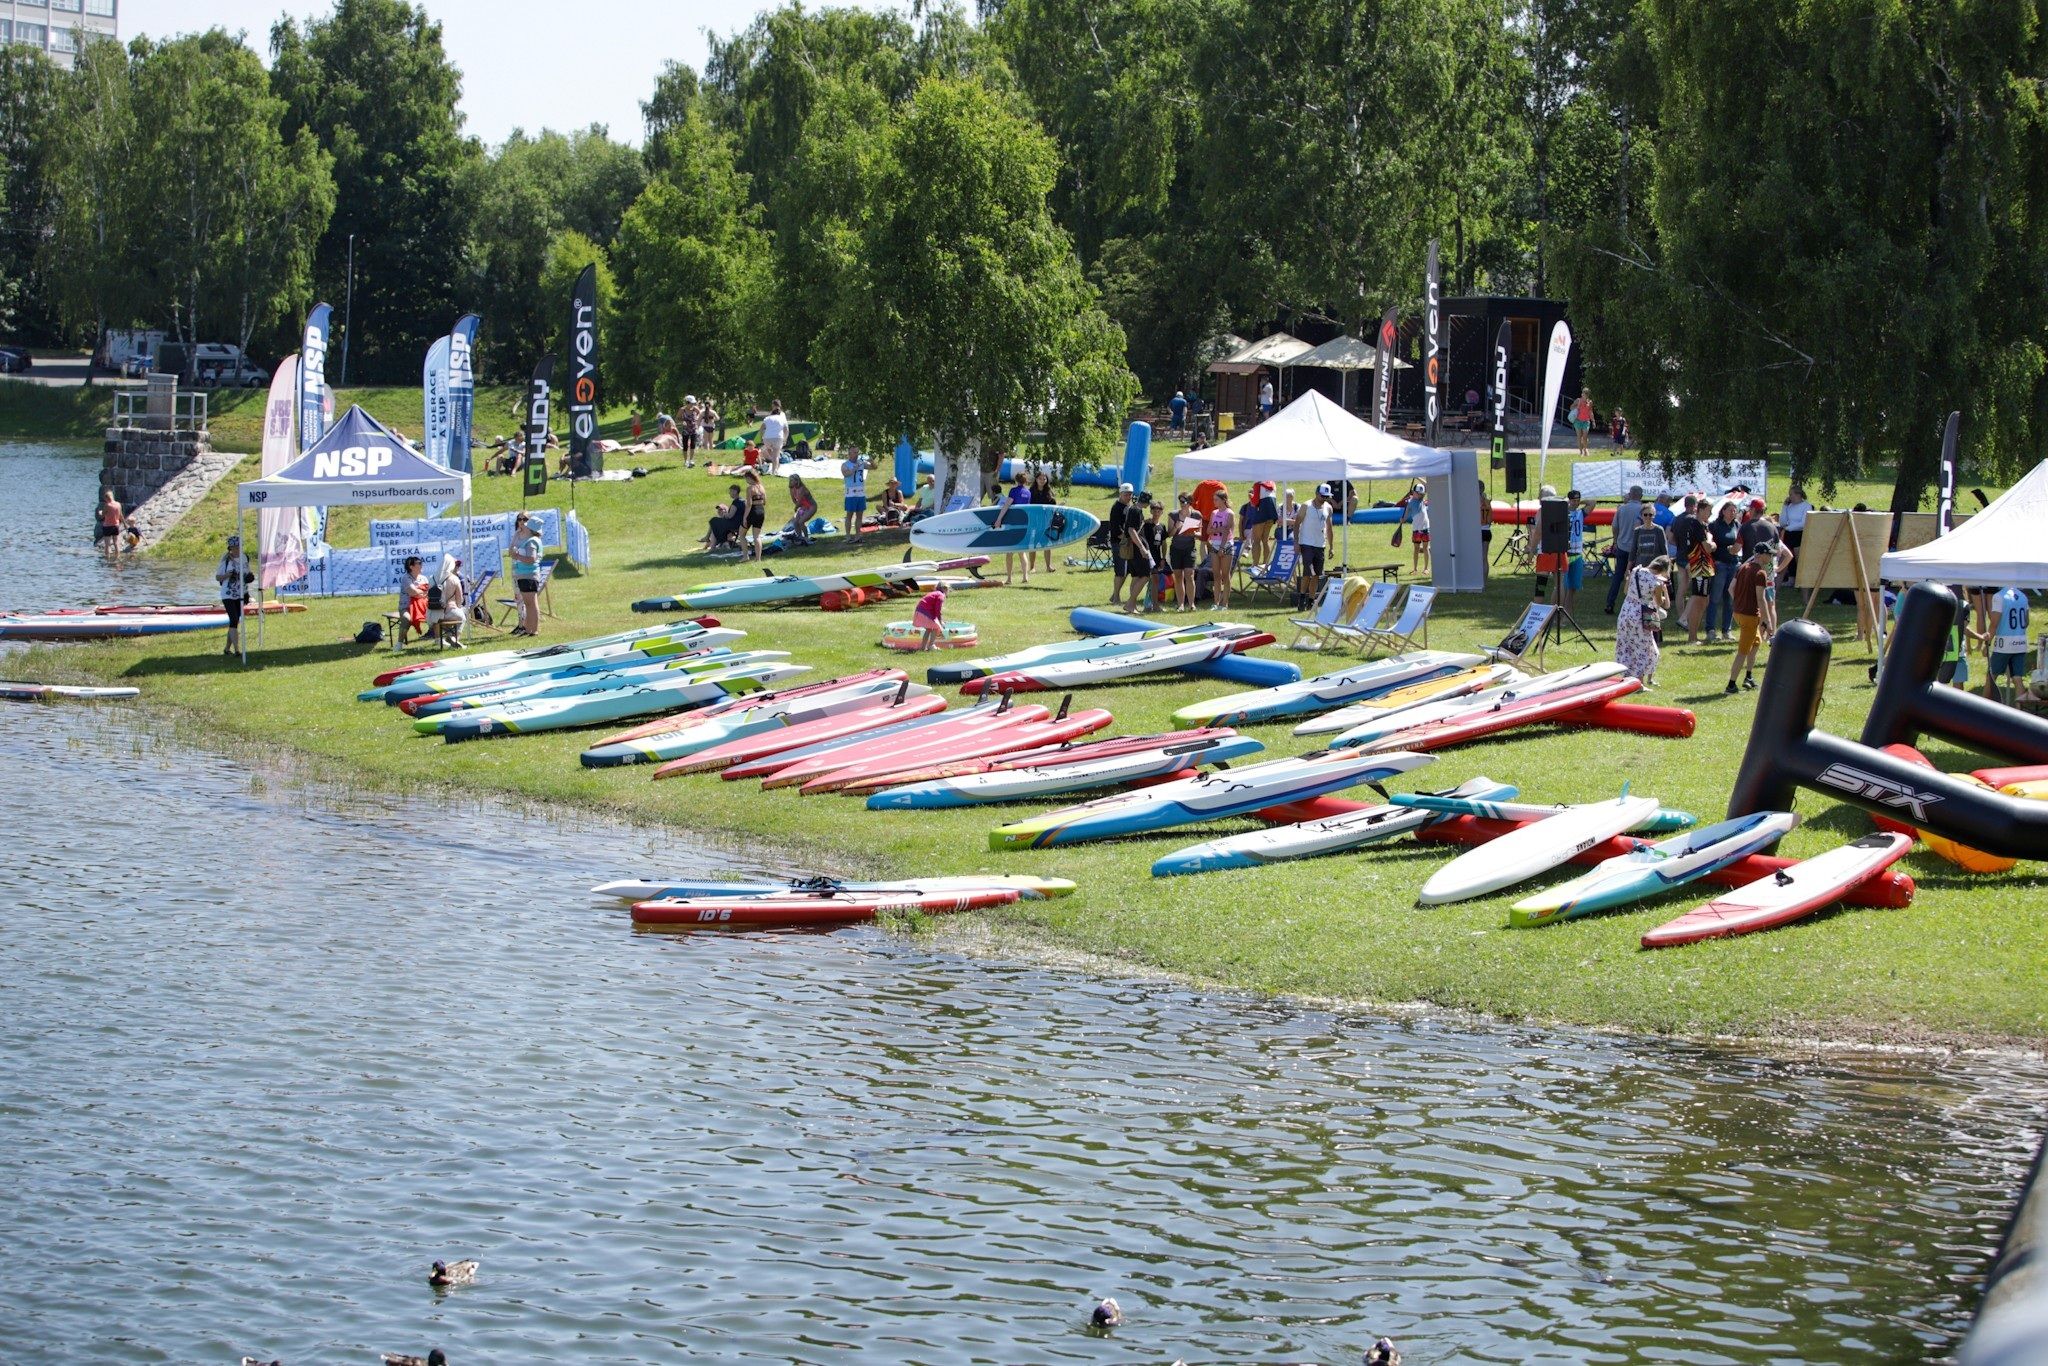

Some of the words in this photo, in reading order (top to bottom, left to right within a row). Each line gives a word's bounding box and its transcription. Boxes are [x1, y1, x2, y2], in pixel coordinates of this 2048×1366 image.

[305, 326, 327, 395] NSP
[449, 333, 473, 388] NSP
[1494, 345, 1507, 432] HUDY
[530, 379, 549, 459] HUDY
[313, 447, 393, 478] NSP
[249, 491, 267, 503] NSP
[352, 487, 455, 499] nspsurfboards.com
[375, 521, 401, 530] ČESKÁ
[390, 547, 420, 556] ČESKÁ
[1277, 545, 1295, 570] NSP
[2009, 608, 2027, 629] 60
[479, 723, 493, 733] NSP
[622, 754, 636, 764] NSP
[1815, 762, 1946, 823] STX
